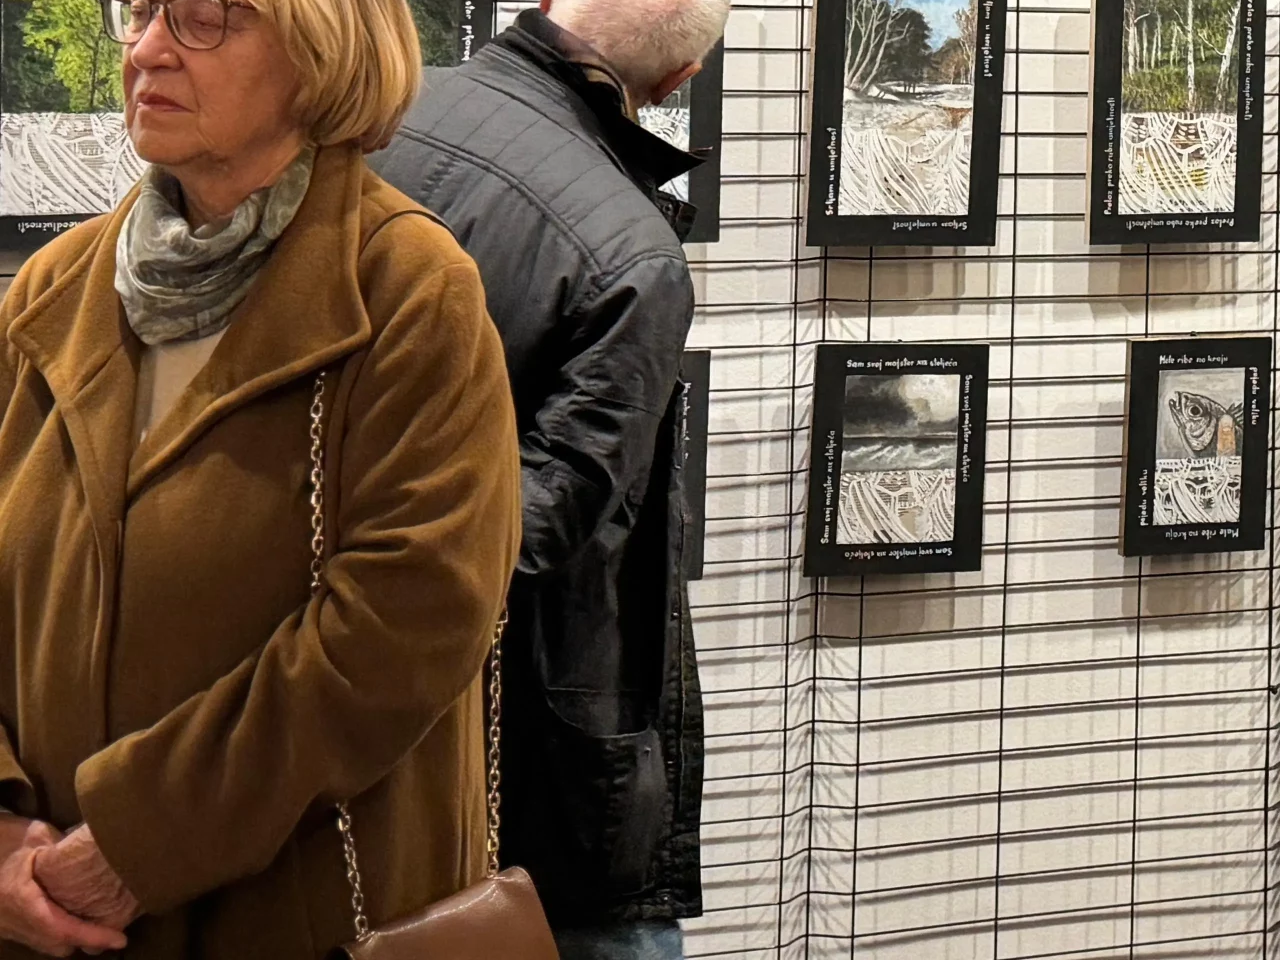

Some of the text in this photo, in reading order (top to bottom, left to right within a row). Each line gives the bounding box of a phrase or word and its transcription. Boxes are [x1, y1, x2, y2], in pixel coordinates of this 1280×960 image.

[846, 359, 865, 368] Sam
[866, 358, 883, 371] svoj
[1207, 354, 1229, 365] kraju
